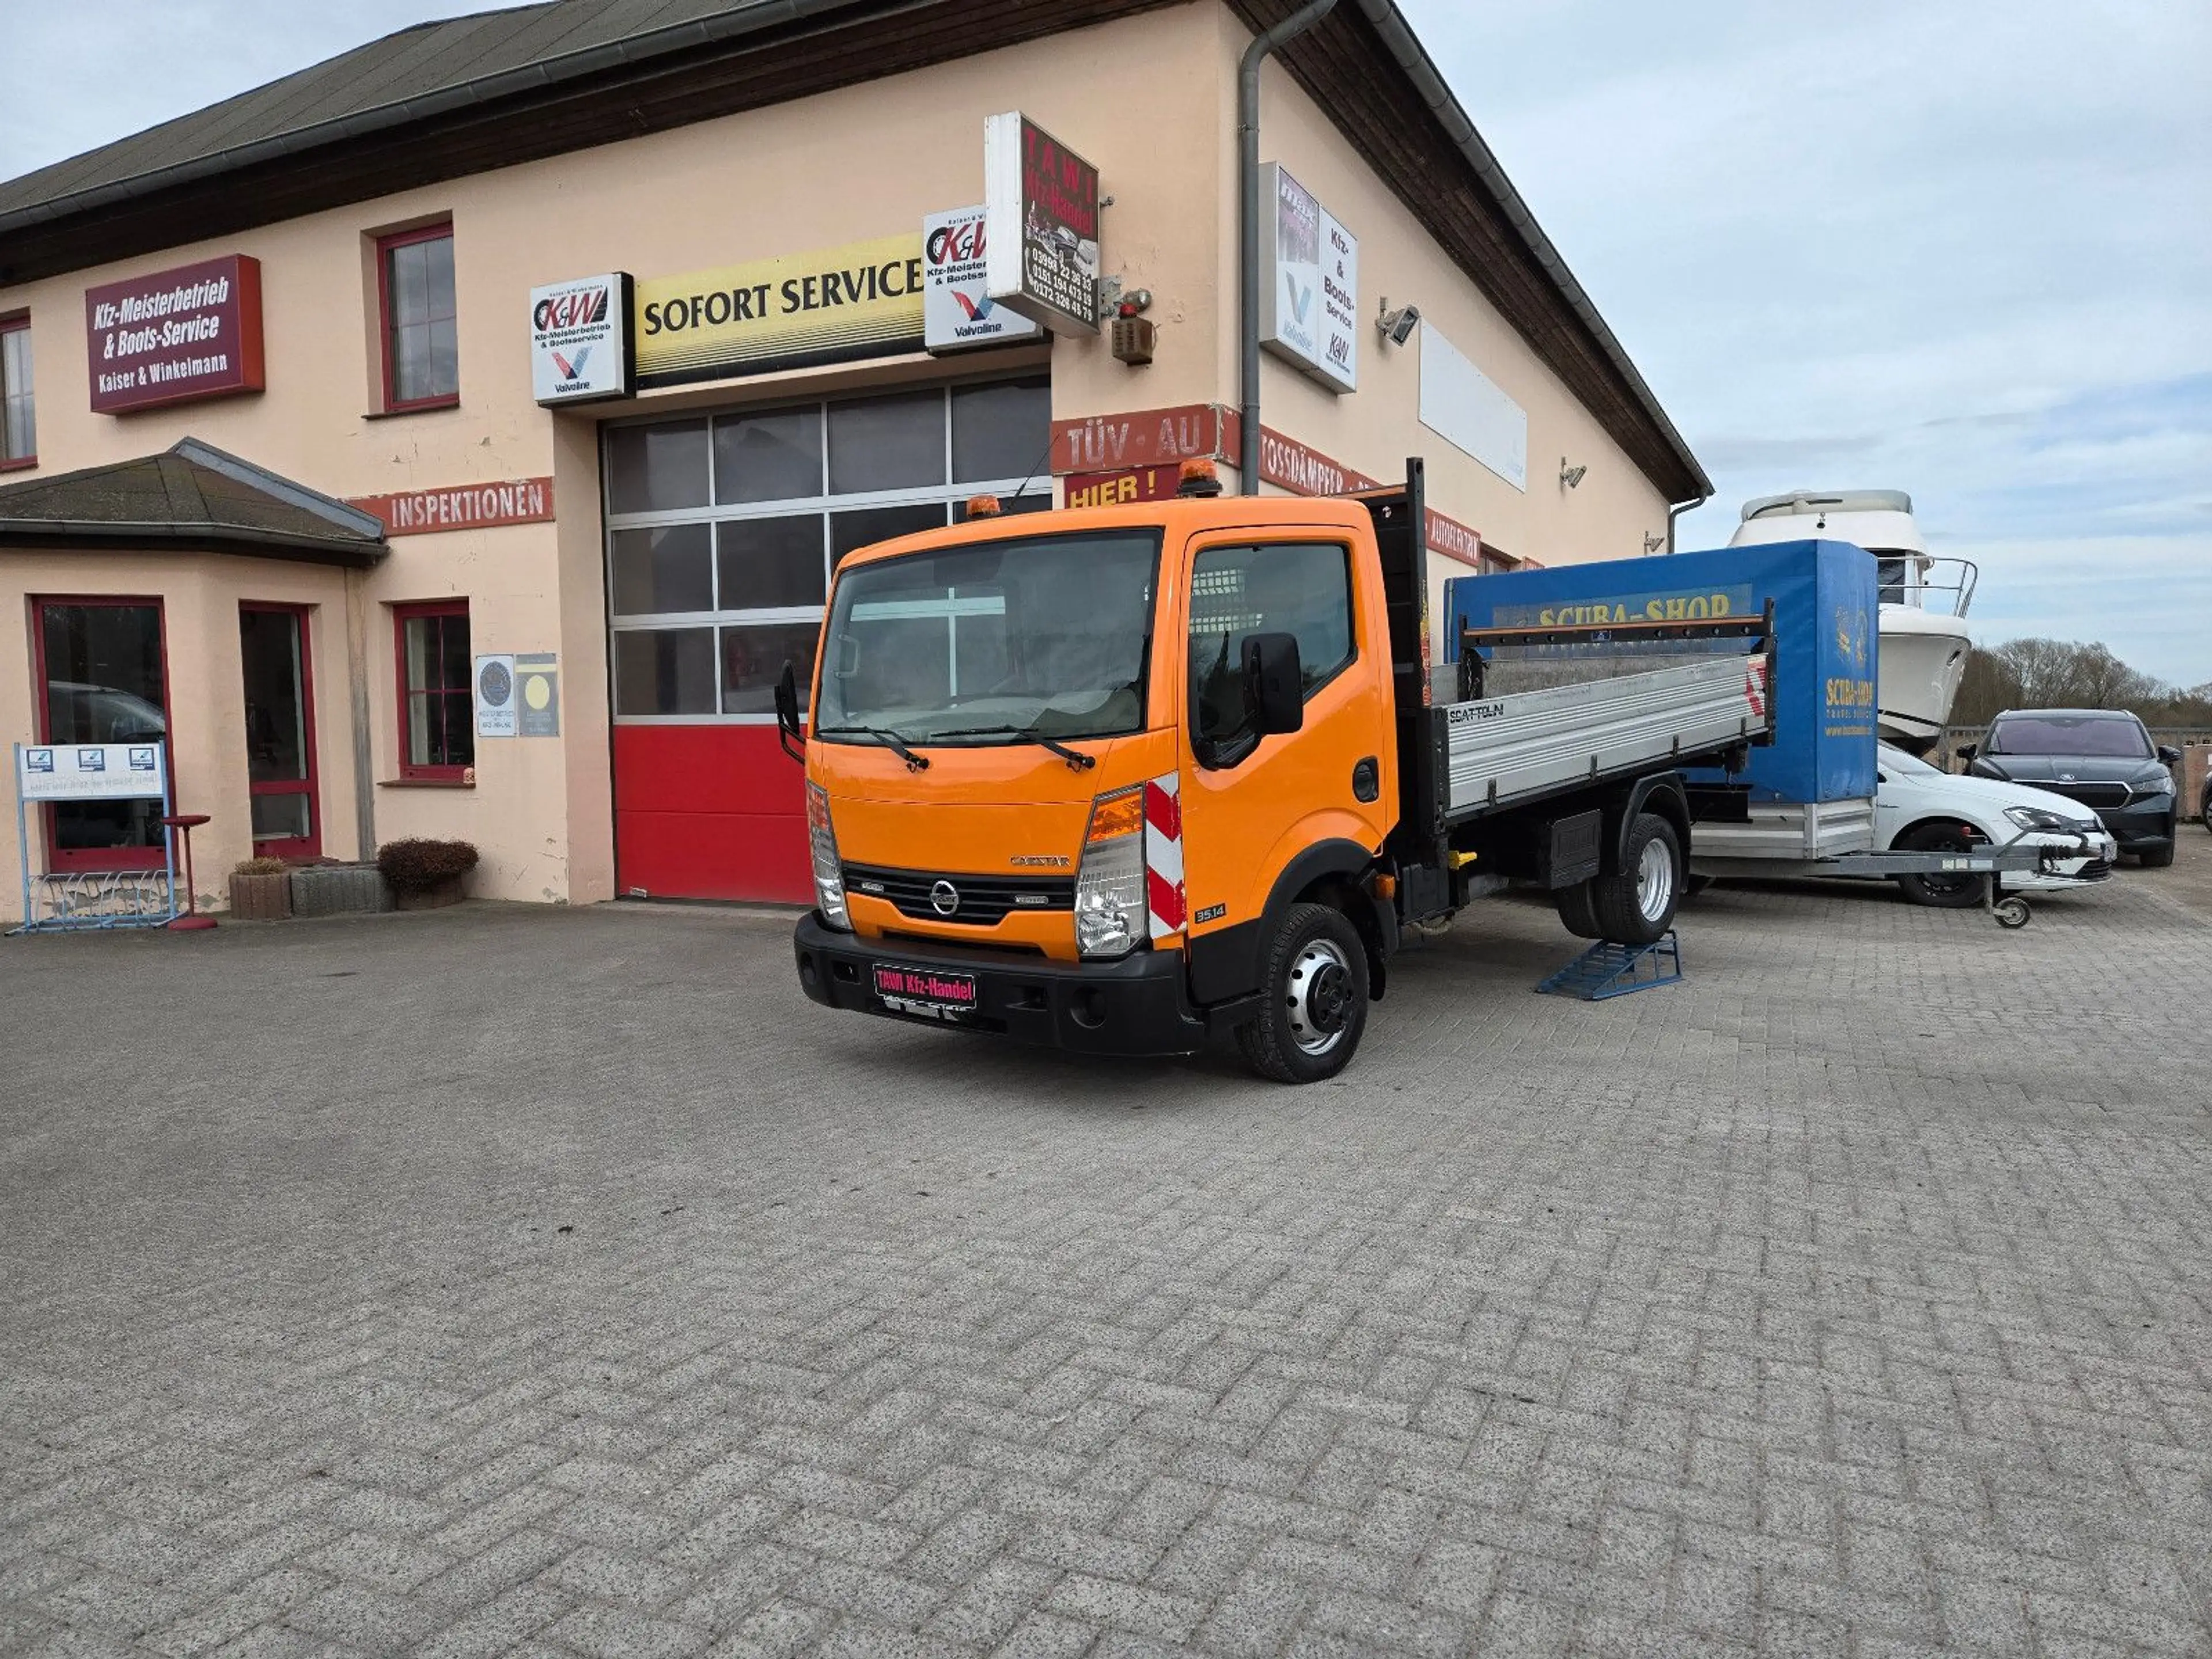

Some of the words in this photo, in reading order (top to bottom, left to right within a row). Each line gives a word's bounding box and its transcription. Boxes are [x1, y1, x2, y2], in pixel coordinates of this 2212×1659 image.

[1331, 228, 1349, 255] Kfz-
[935, 277, 943, 286] &
[1032, 264, 1052, 285] 0151
[1060, 264, 1070, 280] 22
[1336, 260, 1344, 278] &
[94, 276, 229, 330] Kfz-Meisterbetrieb
[645, 284, 771, 335] SOFORT
[781, 257, 925, 313] SERVICE
[1033, 280, 1054, 302] 0172
[1326, 300, 1352, 330] Service
[104, 333, 115, 360] &
[118, 314, 219, 357] Boots-Service
[535, 323, 611, 342] Kfz-Meisterbetrieb
[955, 323, 1002, 337] Valvoline
[541, 341, 547, 349] &
[99, 372, 135, 393] Kaiser
[138, 366, 147, 386] &
[149, 353, 228, 384] Winkelmann
[555, 381, 590, 393] Valvoline
[1067, 418, 1129, 465] TÜV
[1156, 414, 1200, 458] AU
[391, 483, 543, 528] INSPEKTIONEN
[1070, 475, 1138, 509] HIER
[877, 969, 904, 992] TAWI
[906, 974, 973, 1001] Kfz-Handel
